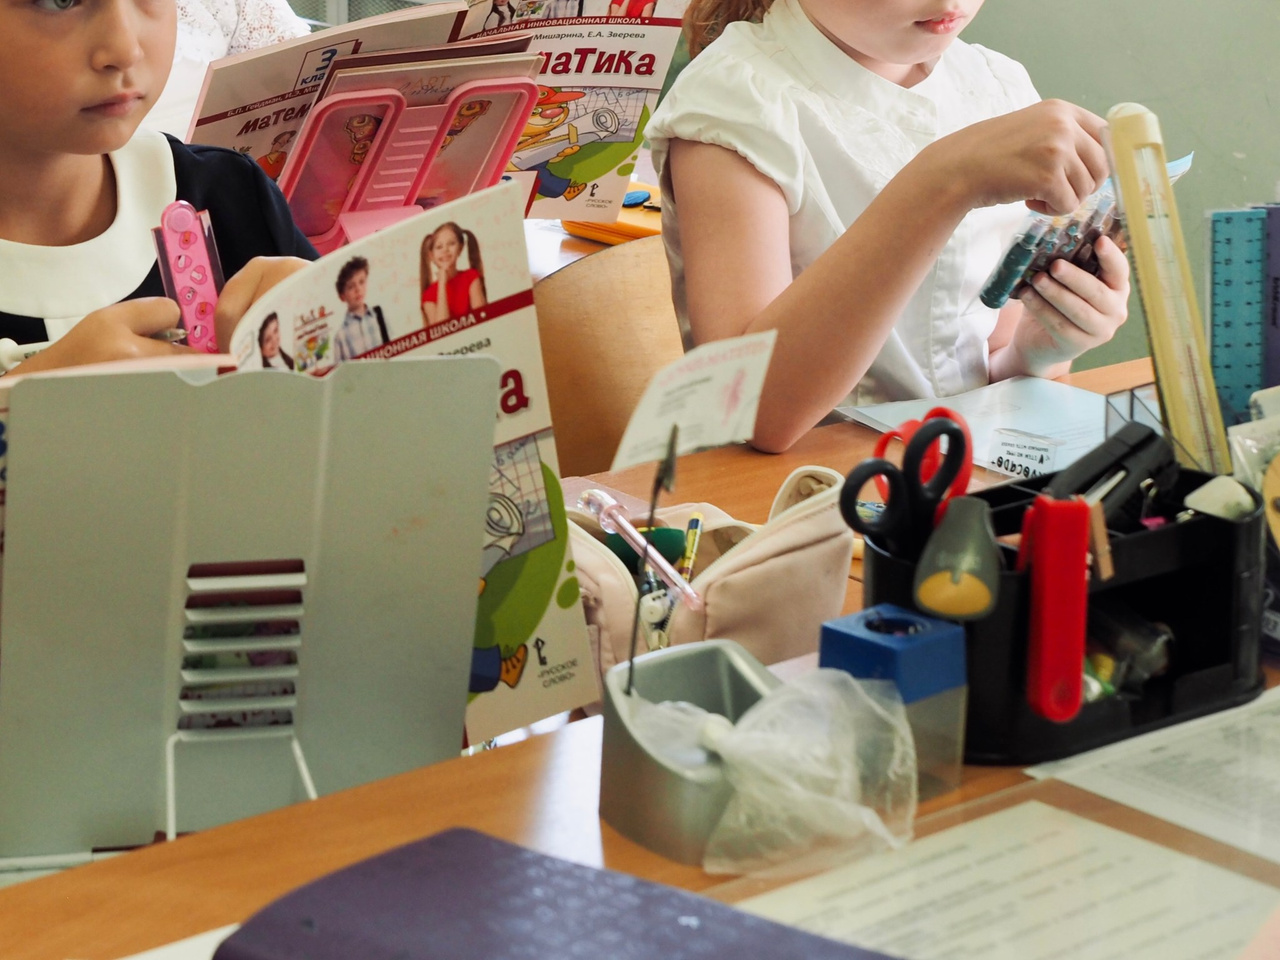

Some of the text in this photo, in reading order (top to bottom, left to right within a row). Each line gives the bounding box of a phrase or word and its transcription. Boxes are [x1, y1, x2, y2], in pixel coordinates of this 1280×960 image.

[477, 16, 641, 39] НАЧАЛЬНАЯ ИННОВАЦИОННАЯ ШКОЛА
[533, 30, 646, 40] Мишарина, Е.А. Зверева
[315, 48, 338, 71] 3
[429, 313, 477, 339] ШКОЛА
